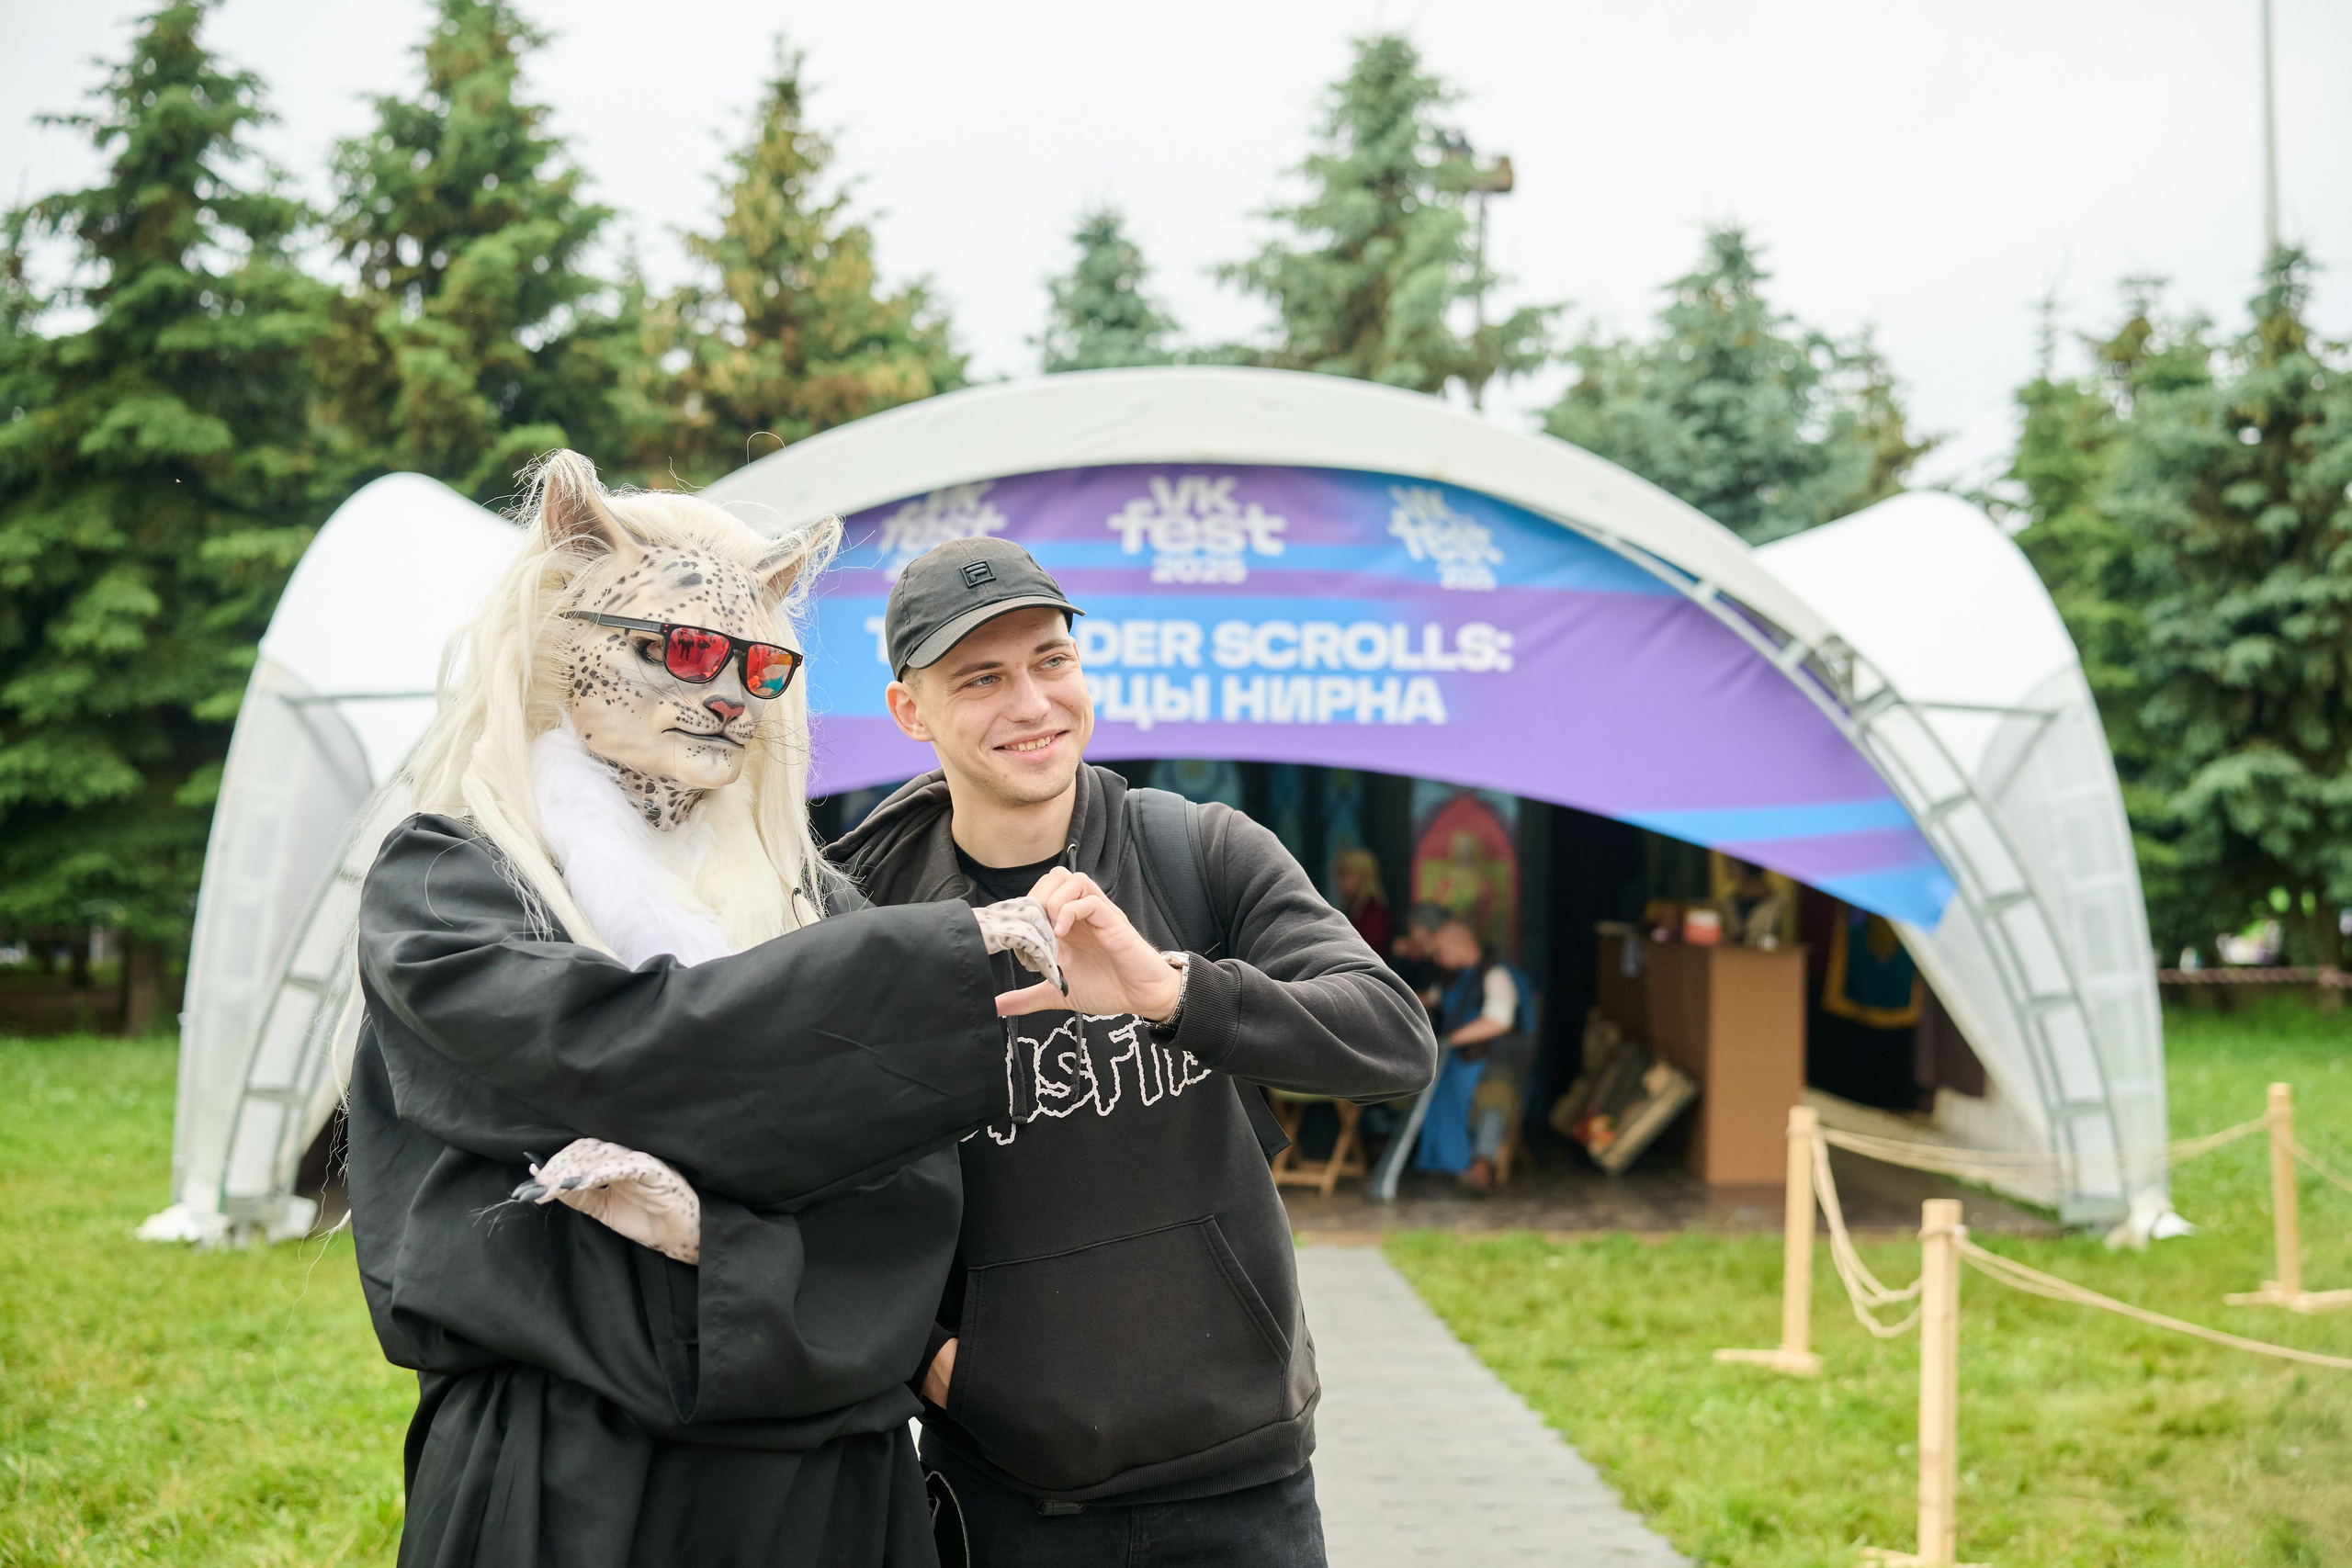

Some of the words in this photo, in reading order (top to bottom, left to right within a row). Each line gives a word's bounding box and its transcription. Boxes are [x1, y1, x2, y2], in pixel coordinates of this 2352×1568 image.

[1149, 476, 1238, 512] VK
[1107, 498, 1286, 556] fest
[1150, 557, 1248, 584] 2025
[1076, 620, 1202, 668] DER
[1211, 620, 1513, 671] SCROLLS:
[1222, 674, 1448, 726] НИРНА
